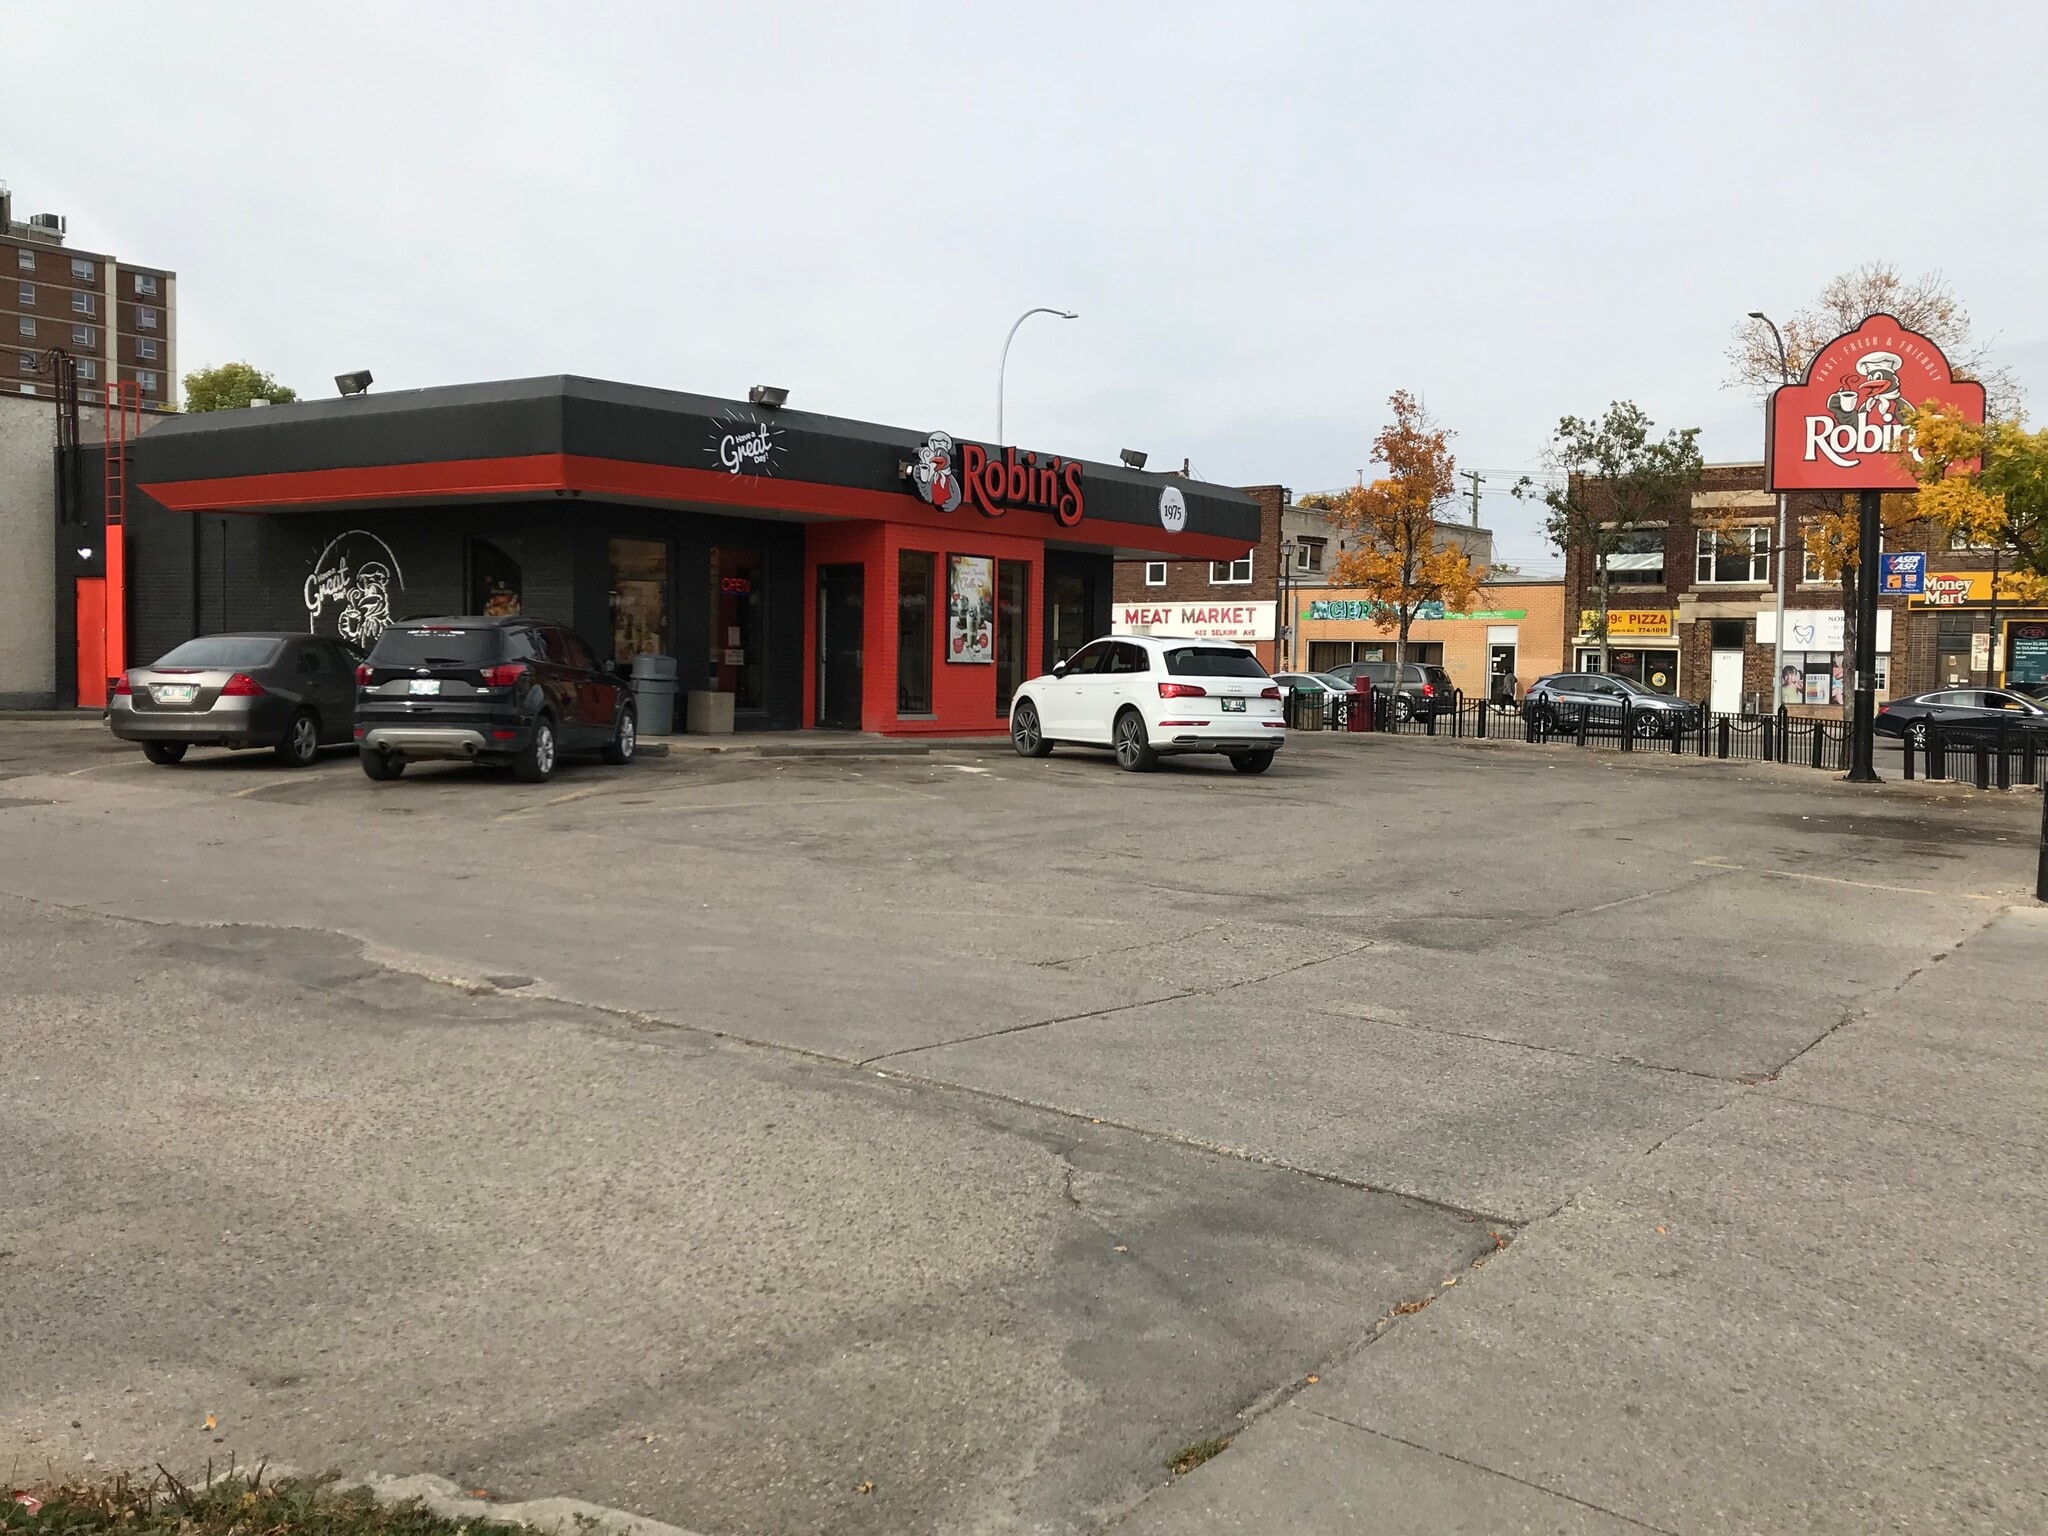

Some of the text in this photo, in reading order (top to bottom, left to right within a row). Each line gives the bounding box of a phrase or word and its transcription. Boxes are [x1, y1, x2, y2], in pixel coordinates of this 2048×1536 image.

[1844, 336, 1879, 356] FRESH
[1899, 340, 1943, 382] FRIENDLY
[720, 422, 773, 474] Great
[1163, 504, 1182, 521] 1975
[1888, 555, 1921, 564] LASER
[303, 556, 350, 617] Great
[1924, 575, 1974, 595] Money
[1924, 590, 1965, 605] Mart
[1125, 607, 1257, 625] MEAT MARKET
[1629, 614, 1668, 625] PIZZA
[1211, 629, 1238, 637] SELKIRK
